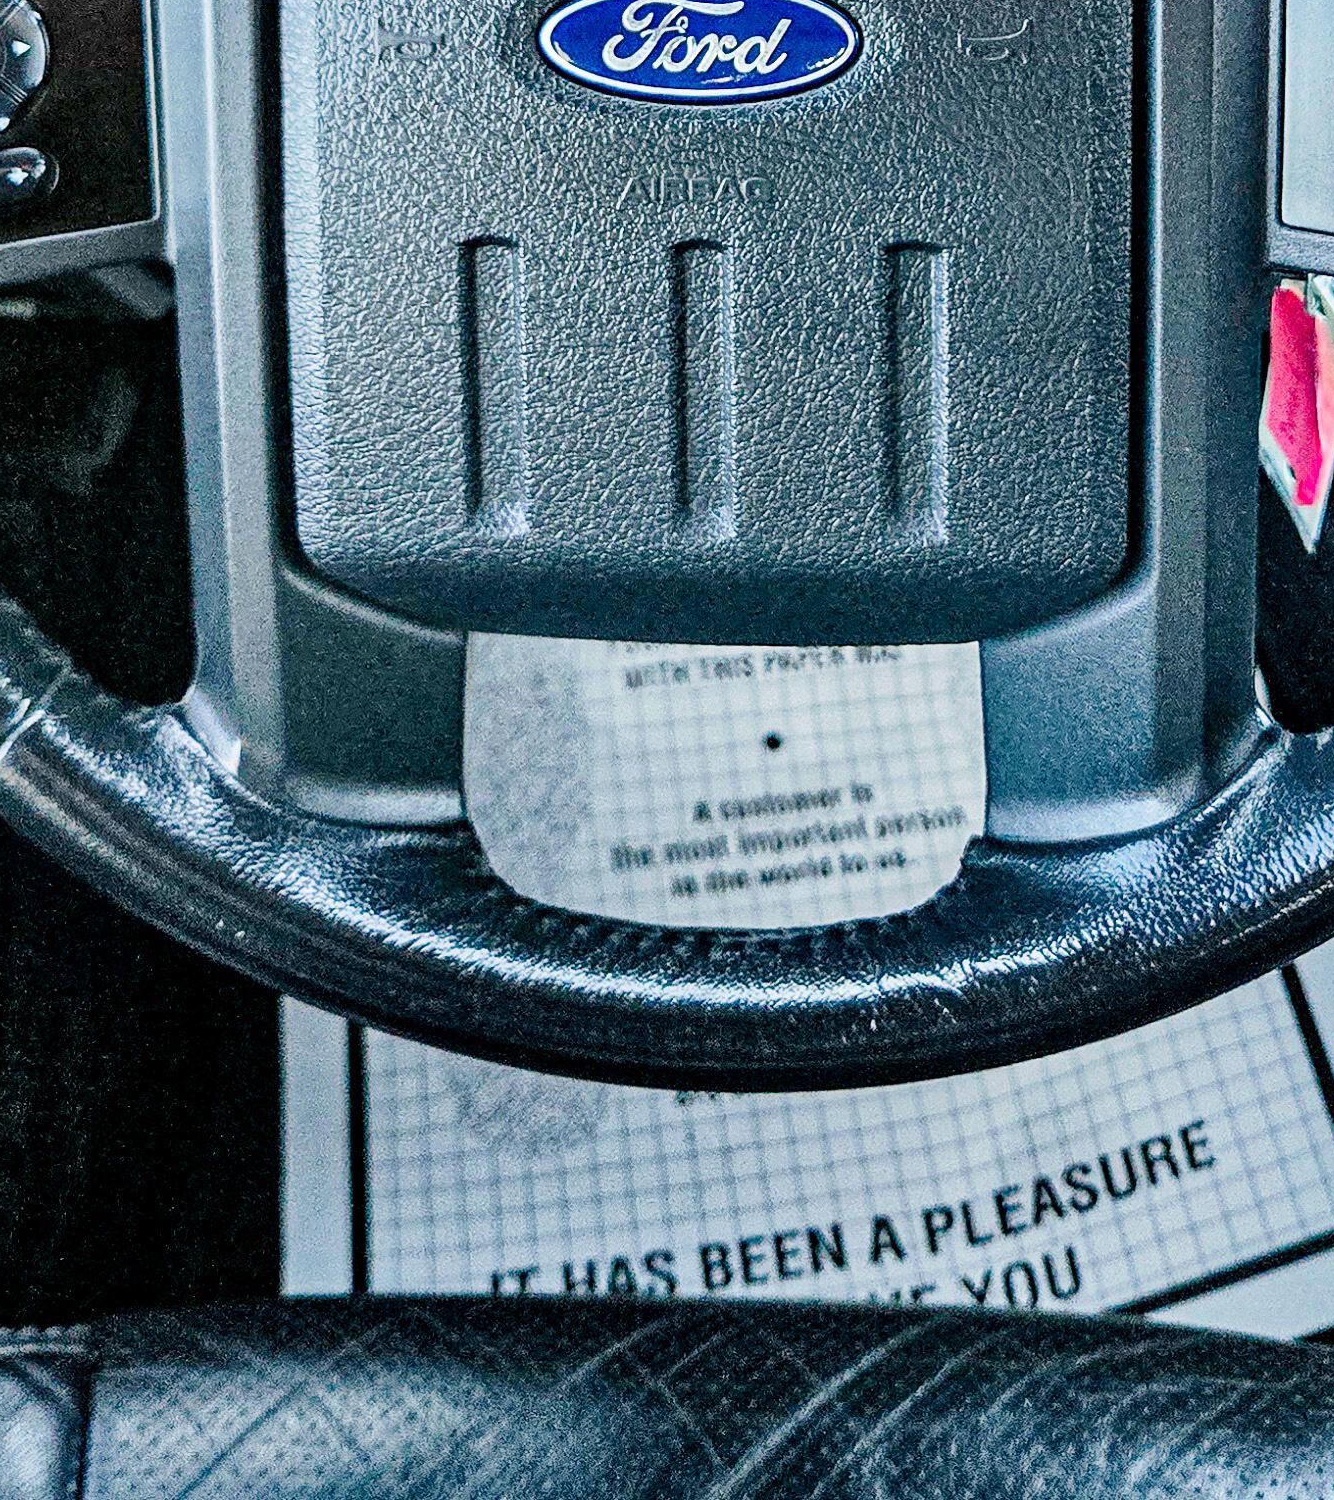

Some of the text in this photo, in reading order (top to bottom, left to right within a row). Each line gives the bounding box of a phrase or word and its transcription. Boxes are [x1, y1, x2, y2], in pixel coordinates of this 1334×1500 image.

[490, 1119, 1217, 1297] IT HAS BEEN A PLEASURE
[962, 1244, 1082, 1308] YOU
